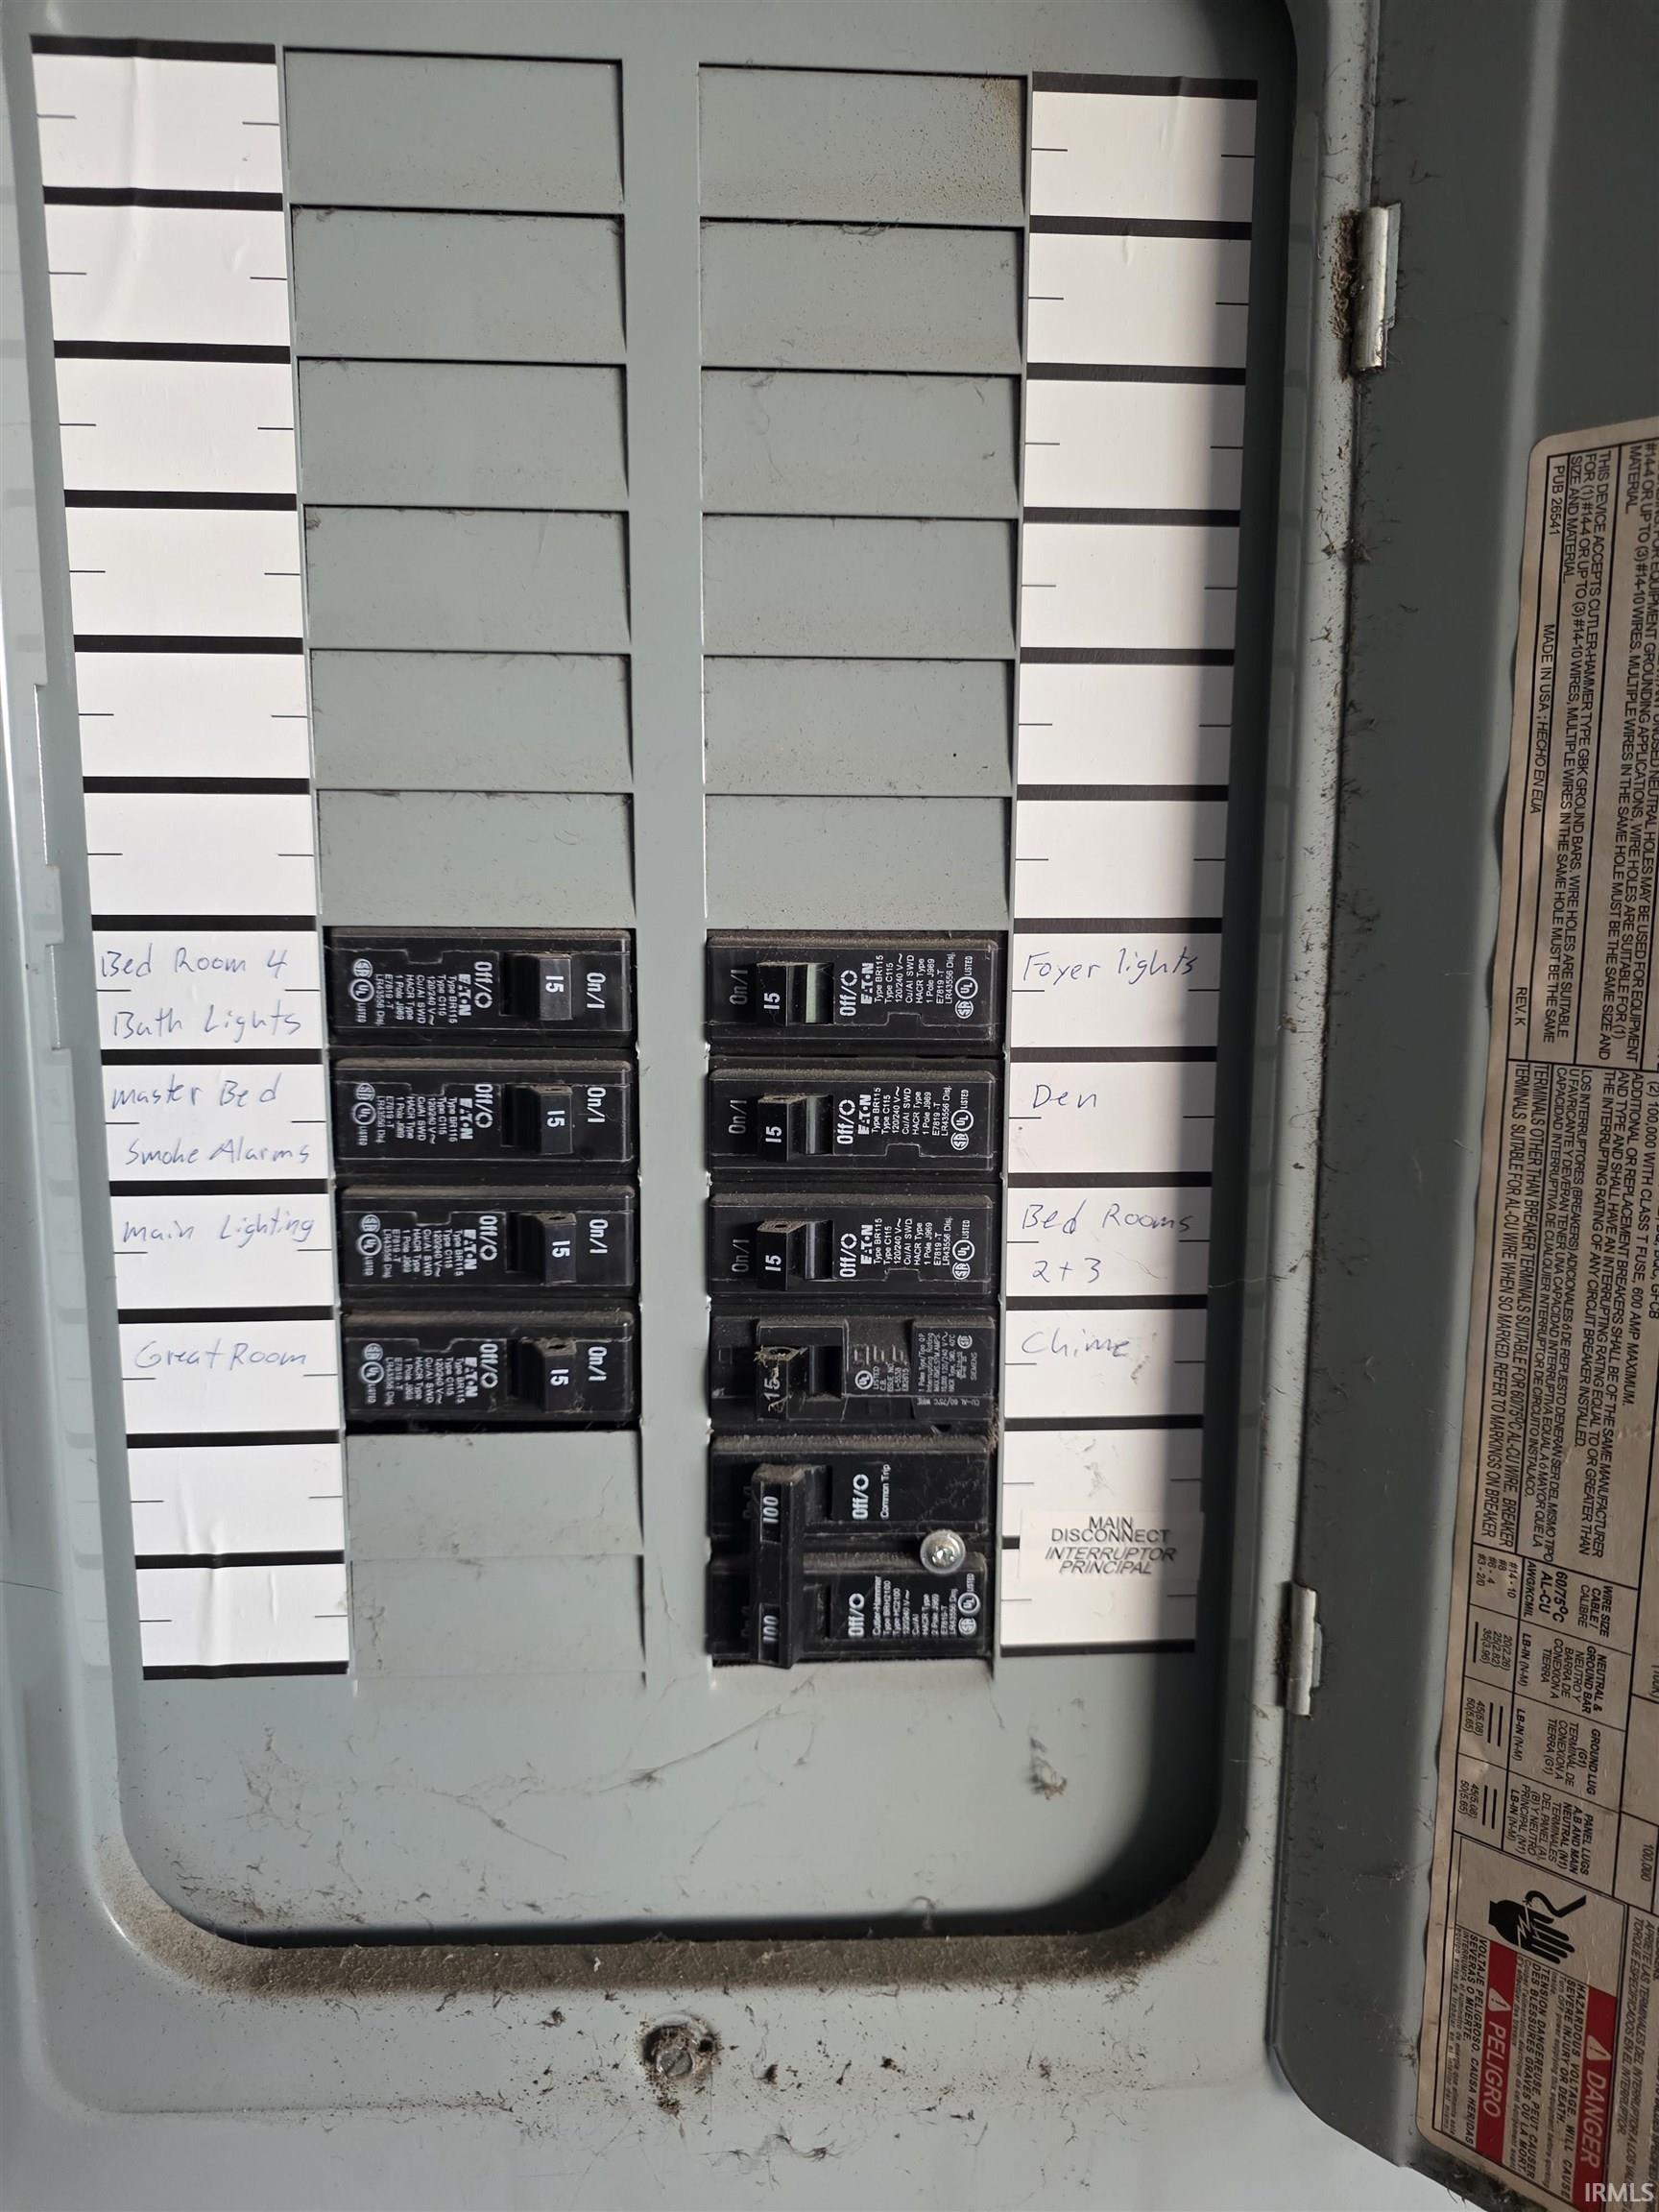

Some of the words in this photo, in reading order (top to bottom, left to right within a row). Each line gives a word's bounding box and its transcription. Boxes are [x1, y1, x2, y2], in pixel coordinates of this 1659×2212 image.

[1552, 466, 1565, 493] PUB
[1570, 456, 1582, 485] SIZE
[1584, 454, 1597, 482] FOR
[1598, 450, 1611, 480] THIS
[1550, 497, 1563, 535] 26541
[1568, 488, 1580, 516] AND
[1595, 485, 1609, 531] DEVICE
[1563, 518, 1578, 583] MATERIAL.
[1578, 538, 1591, 558] OR
[1576, 561, 1589, 579] UP
[1590, 536, 1605, 595] ACCEPTS
[1575, 583, 1588, 598] TO
[1542, 624, 1555, 661] MADE
[1581, 598, 1600, 709] CUTLER-HAMMER
[1541, 666, 1552, 680] IN
[1538, 684, 1551, 714] USA
[1534, 722, 1549, 766] HECHO
[1563, 707, 1578, 766] MULTIPLE
[1579, 714, 1593, 744] TYPE
[1576, 748, 1590, 776] GBK
[1533, 769, 1545, 786] EN
[1560, 769, 1575, 808] WIRES
[1531, 788, 1544, 813] EUA
[1573, 778, 1588, 832] GROUND
[1559, 812, 1572, 824] IN
[1557, 827, 1571, 852] THE
[1570, 836, 1584, 872] BARS.
[1554, 854, 1569, 888] SAME
[1568, 876, 1581, 906] WIRE
[1552, 892, 1566, 924] HOLE
[1550, 927, 1563, 961] MUST
[1564, 910, 1578, 950] HOLES
[101, 943, 153, 977] Bed
[175, 947, 246, 974] Room
[267, 950, 288, 979] 4
[875, 954, 883, 982] BR115
[916, 958, 926, 977] Type
[964, 956, 973, 975] LISTED
[1023, 951, 1101, 985] Foyer
[1548, 964, 1560, 980] BE
[1562, 953, 1575, 978] ARE
[545, 975, 564, 993] 15
[875, 985, 883, 1002] Type
[885, 985, 894, 1003] Type
[1547, 984, 1559, 1006] THE
[764, 993, 780, 1010] 15
[1515, 987, 1527, 1014] REV.
[1558, 982, 1574, 1037] SUITABLE
[1544, 1009, 1557, 1042] SAME
[219, 1072, 282, 1108] Bed
[1033, 1084, 1096, 1108] Den
[1530, 1065, 1551, 1124] TERMINALS
[547, 1110, 565, 1127] 15
[766, 1126, 781, 1142] 15
[1527, 1128, 1545, 1165] OTHER
[209, 1137, 309, 1164] Alarms
[1525, 1168, 1542, 1197] THAN
[219, 1207, 315, 1248] Lighting
[1022, 1199, 1087, 1235] Bed
[1102, 1204, 1193, 1233] Rooms
[1521, 1200, 1539, 1249] BREAKER
[552, 1240, 570, 1258] 15
[765, 1255, 781, 1271] 15
[1516, 1253, 1535, 1311] TERMINALS
[1022, 1327, 1130, 1357] Chime
[1512, 1314, 1531, 1363] SUITABLE
[134, 1338, 223, 1369] Great
[230, 1342, 305, 1371] Room
[551, 1369, 568, 1385] 15
[1511, 1367, 1527, 1386] FOR
[1505, 1432, 1522, 1461] AL-CU
[880, 1464, 890, 1480] Trip
[1503, 1465, 1520, 1491] WIRE.
[763, 1496, 779, 1524] 100
[880, 1483, 889, 1519] Common
[1051, 1528, 1171, 1542] DISCONNECT
[1089, 1517, 1133, 1528] MAIN
[1499, 1498, 1517, 1546] BREAKER
[1045, 1547, 1177, 1561] INTERRUPTOR
[1060, 1561, 1152, 1575] PRINCIPAL
[763, 1616, 777, 1642] 100
[1466, 1935, 1480, 1982] SEVERAS
[1476, 1938, 1489, 1984] VOLTAJE
[1564, 1980, 1576, 2023] SEVERE
[1462, 1996, 1476, 2040] MUERTE.
[1470, 1988, 1486, 2054] PELIGROSO.
[1571, 1984, 1588, 2056] HAZARDOUS
[1560, 2025, 1574, 2064] INJURY
[1468, 2058, 1479, 2093] CAUSA
[1482, 2020, 1507, 2117] PELIGRO
[1559, 2067, 1570, 2083] OR
[1555, 2085, 1569, 2124] DEATH.
[1566, 2064, 1581, 2117] VOLTAGE.
[1464, 2097, 1478, 2144] HERIDAS
[1580, 2070, 1607, 2168] DANGER
[1564, 2125, 1575, 2151] WILL
[1561, 2159, 1574, 2198] CAUSE
